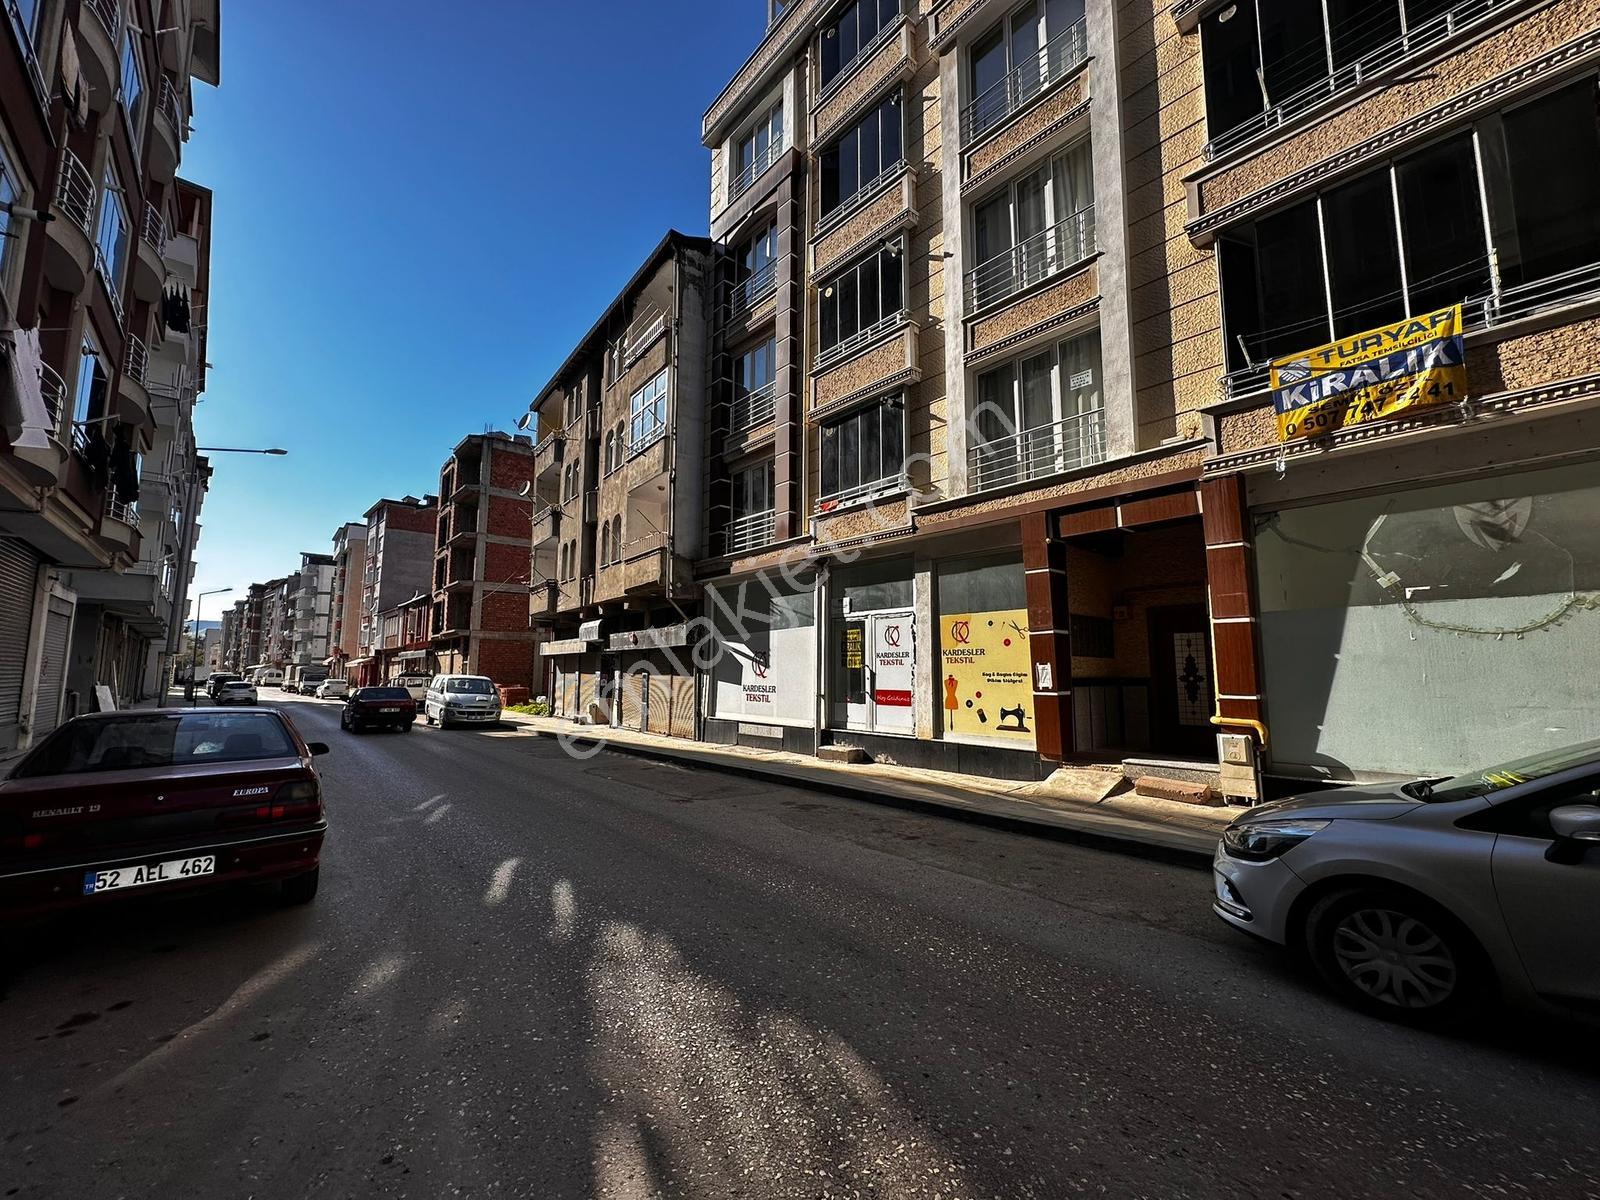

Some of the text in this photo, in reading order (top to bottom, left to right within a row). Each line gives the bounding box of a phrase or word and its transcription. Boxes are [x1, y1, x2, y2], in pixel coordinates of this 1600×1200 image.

[1339, 354, 1370, 367] FATSA
[1303, 411, 1340, 430] 507
[1428, 382, 1455, 397] 41
[942, 648, 985, 657] KARDEŞLER
[232, 786, 269, 797] EUROPA
[31, 805, 84, 819] RENAULT
[95, 871, 120, 890] 52
[133, 865, 169, 885] AEL
[180, 857, 213, 876] 462
